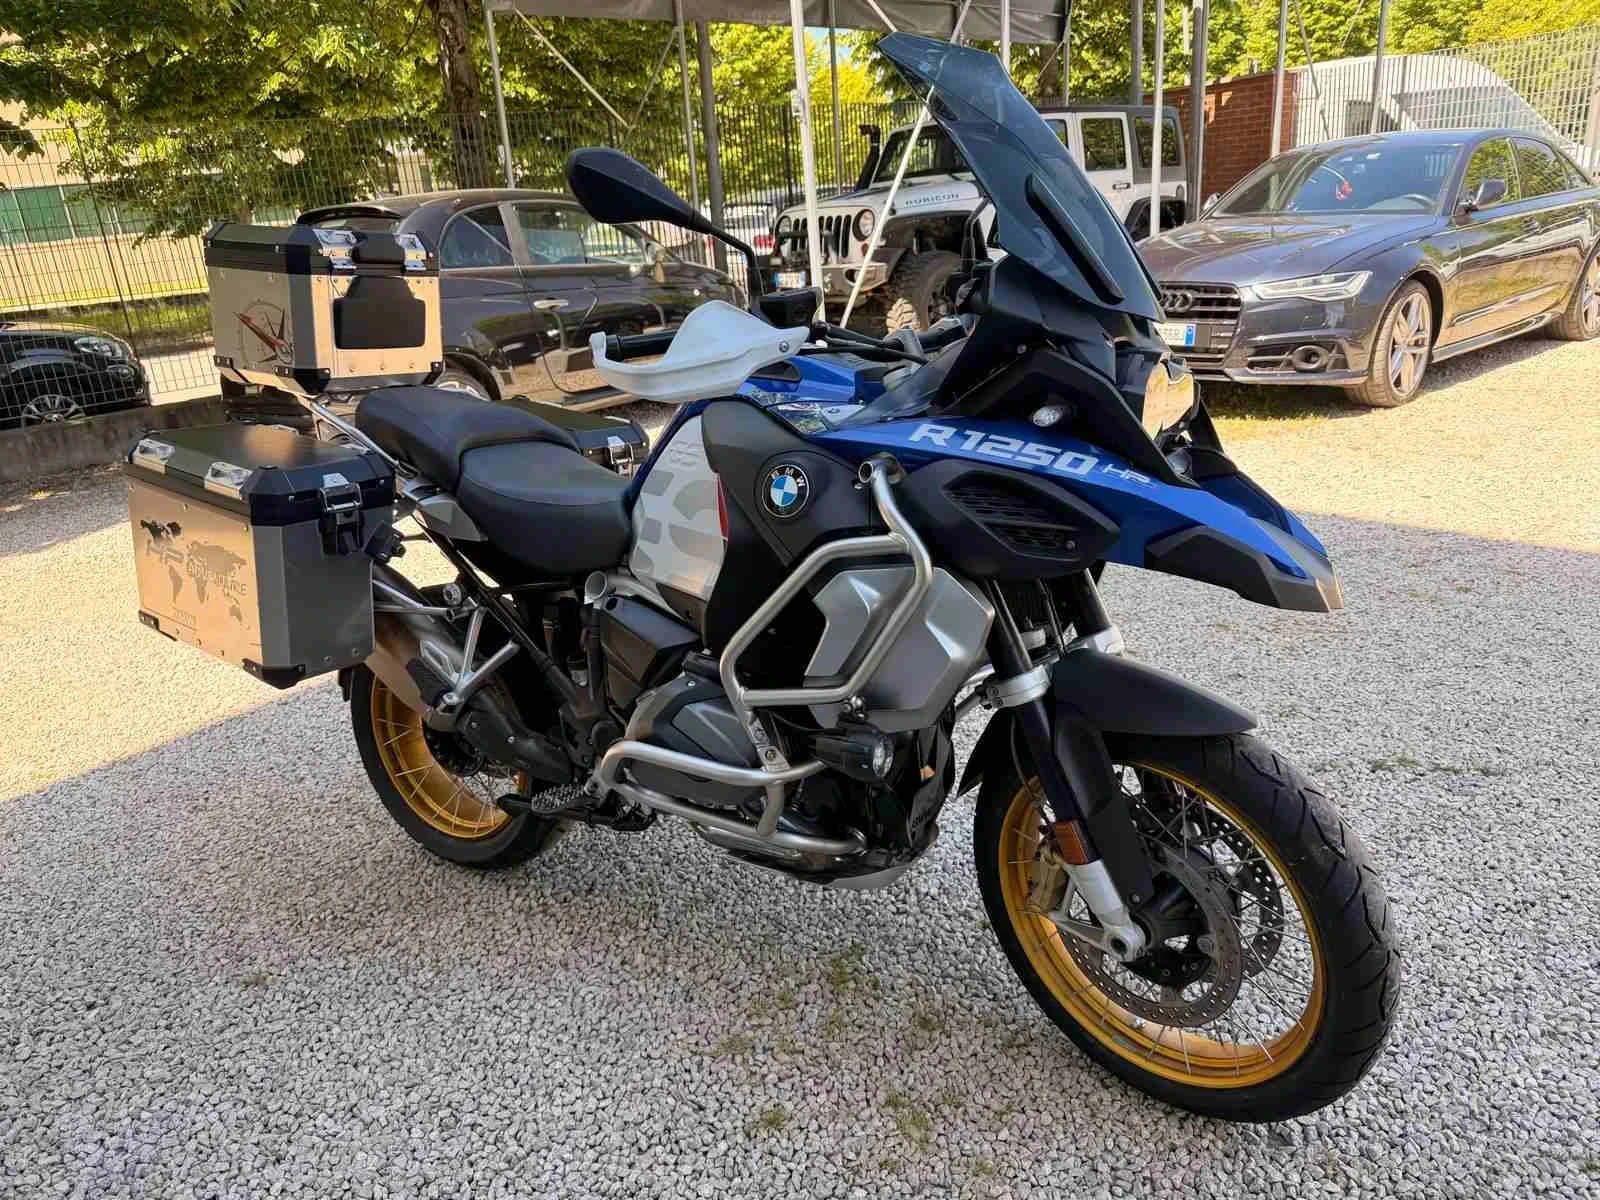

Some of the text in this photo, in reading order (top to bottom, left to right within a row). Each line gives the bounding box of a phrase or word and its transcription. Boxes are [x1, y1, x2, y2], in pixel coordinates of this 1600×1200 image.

[904, 194, 960, 206] RUBICON
[908, 423, 957, 447] R
[959, 430, 1099, 476] 1250
